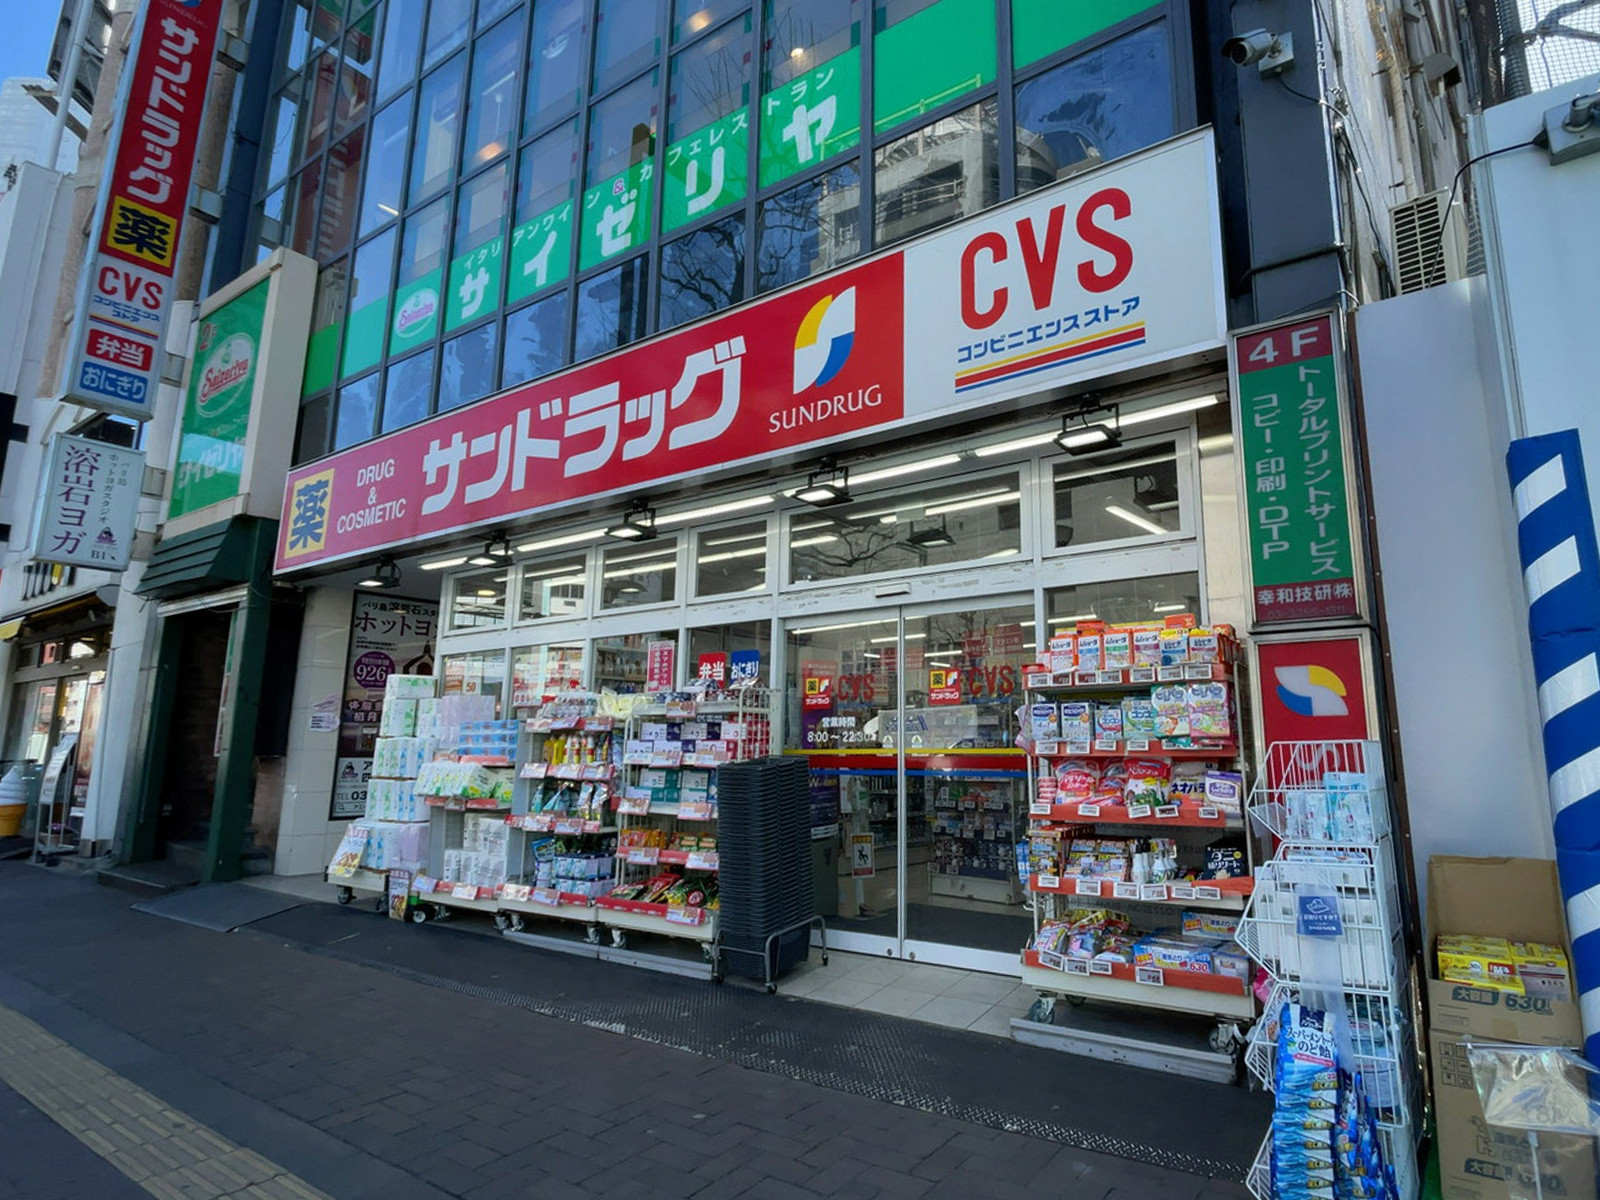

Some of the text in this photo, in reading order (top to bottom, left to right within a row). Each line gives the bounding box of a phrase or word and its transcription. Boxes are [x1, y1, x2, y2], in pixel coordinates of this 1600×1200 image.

[127, 17, 199, 204] サンドラッグ
[459, 95, 838, 318] サイゼリヤ
[113, 204, 171, 260] 薬
[961, 188, 1133, 330] CVS
[98, 266, 163, 310] CVS
[957, 296, 1140, 364] コンビニエンスストア
[97, 335, 145, 368] 弁当
[83, 364, 146, 398] おにぎり
[421, 335, 747, 516] サンドラッグ
[769, 384, 882, 434] SUNDRUG
[357, 458, 395, 487] DRUG
[289, 478, 330, 550] 薬
[336, 498, 406, 534] COSMETIC
[367, 492, 378, 506] &
[354, 611, 438, 638] ホットヨ
[356, 664, 386, 682] 926
[700, 661, 724, 680] 弁当
[731, 661, 759, 679] おにぎり
[837, 673, 875, 701] CVS
[969, 665, 1014, 697] CVS
